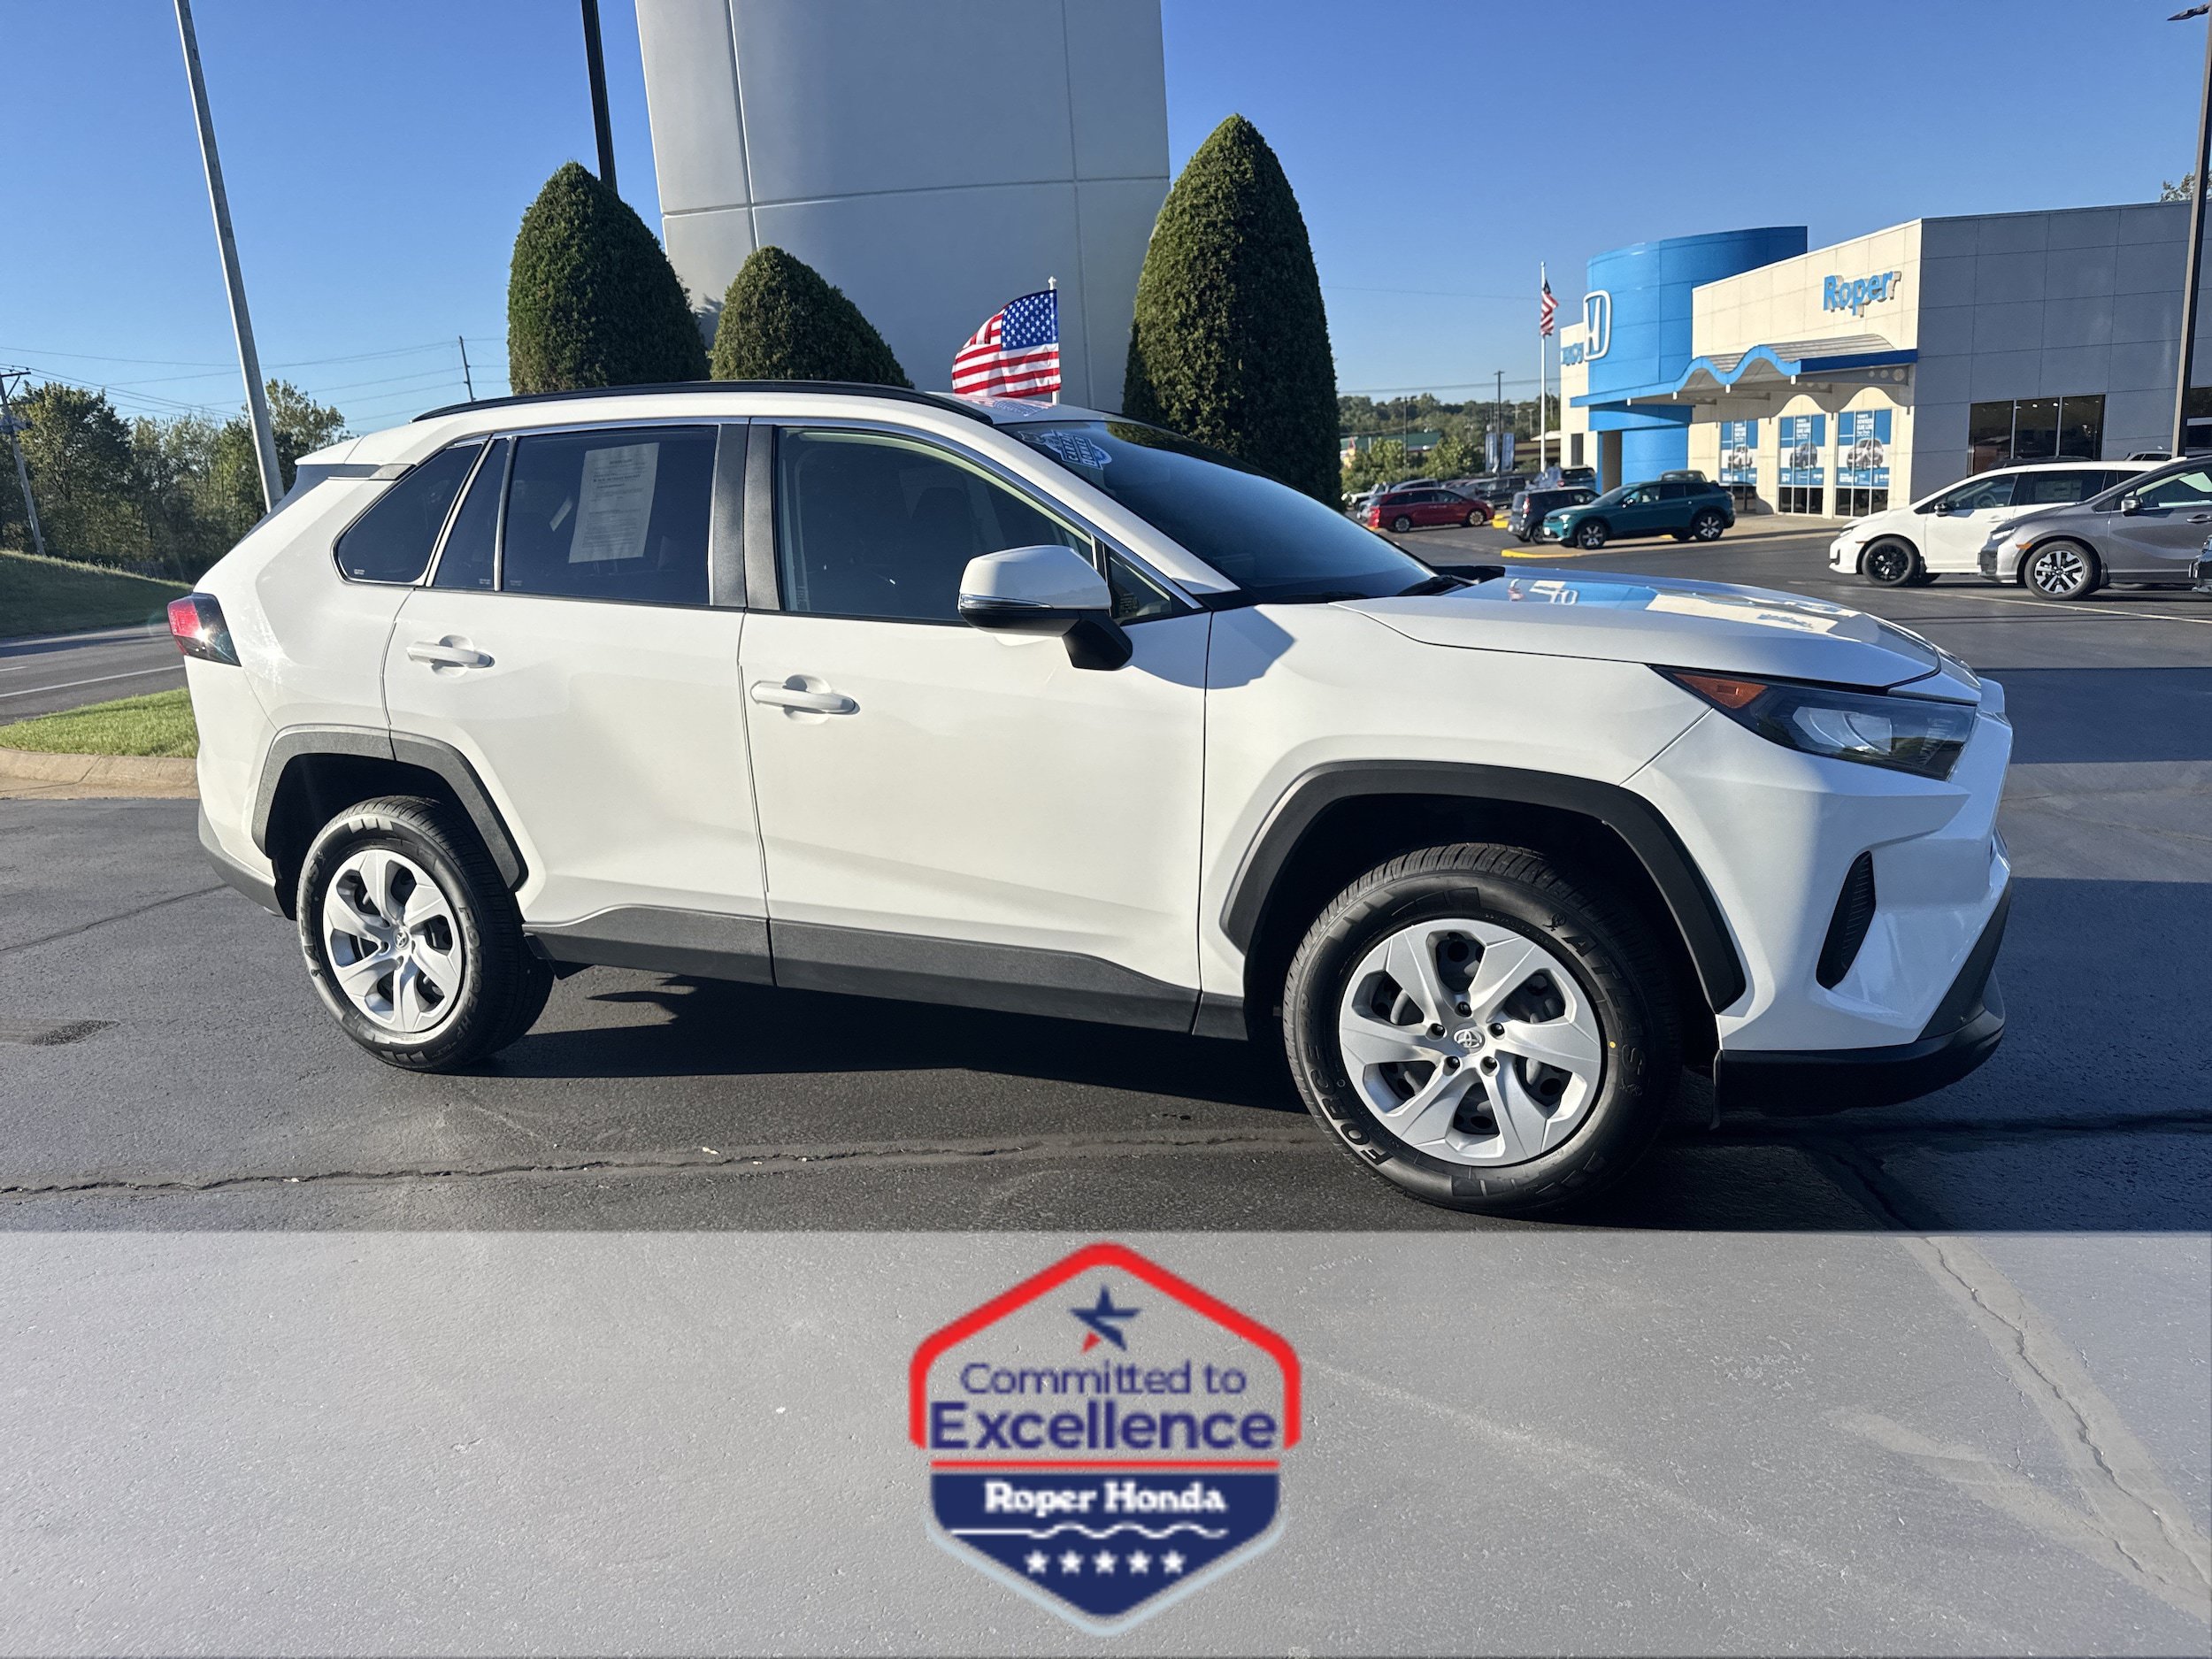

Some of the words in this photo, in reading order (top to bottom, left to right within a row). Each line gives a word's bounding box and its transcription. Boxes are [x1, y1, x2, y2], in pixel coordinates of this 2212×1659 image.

[1823, 270, 1896, 317] Roper
[458, 907, 482, 1013] FORCE
[1304, 1041, 1394, 1165] FORCE
